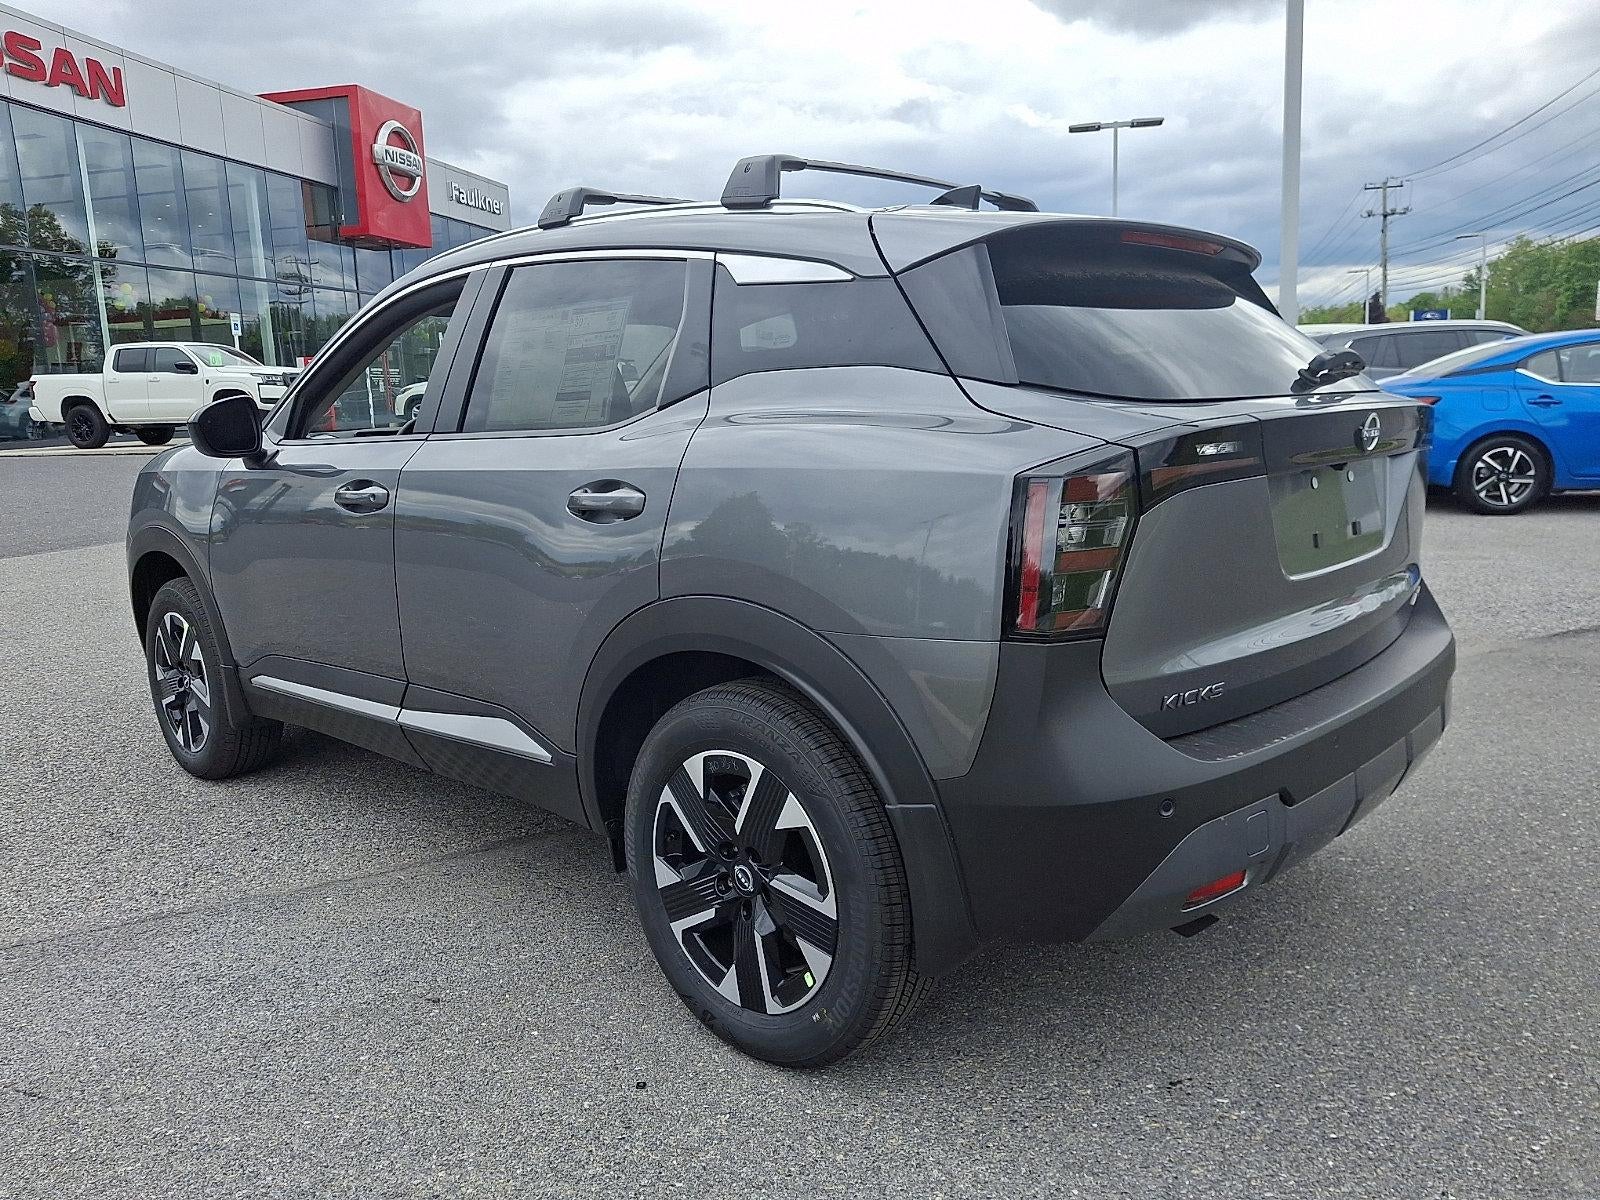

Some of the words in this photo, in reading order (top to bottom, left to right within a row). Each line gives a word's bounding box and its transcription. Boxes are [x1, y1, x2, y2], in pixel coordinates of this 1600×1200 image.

[0, 31, 126, 108] SAN
[384, 149, 422, 172] NISSAN
[450, 182, 503, 214] Faulkner
[1160, 681, 1225, 711] KICKS
